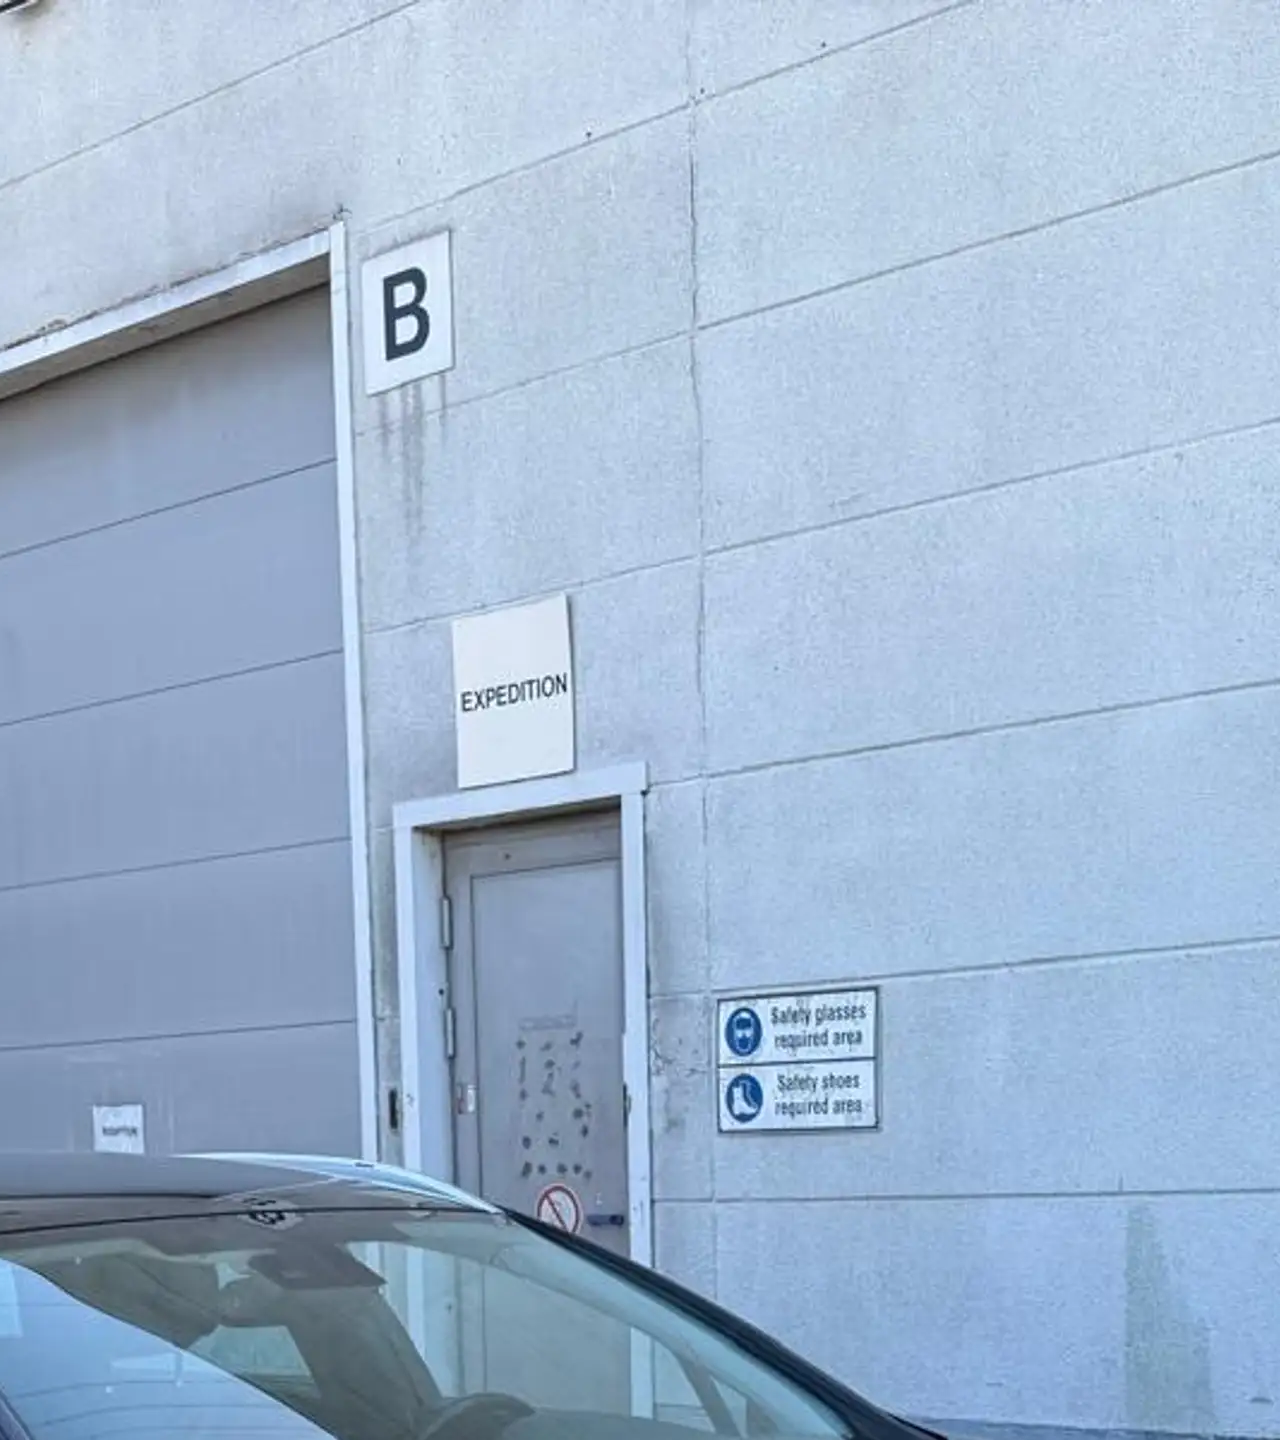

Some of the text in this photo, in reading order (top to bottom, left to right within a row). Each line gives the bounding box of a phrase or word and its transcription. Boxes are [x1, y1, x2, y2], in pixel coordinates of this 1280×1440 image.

[382, 265, 431, 363] B
[460, 672, 568, 712] EXPEDITION
[771, 1003, 866, 1026] Safety glasses
[775, 1030, 862, 1050] required area
[777, 1071, 860, 1093] Safety shoes
[775, 1099, 862, 1118] required area
